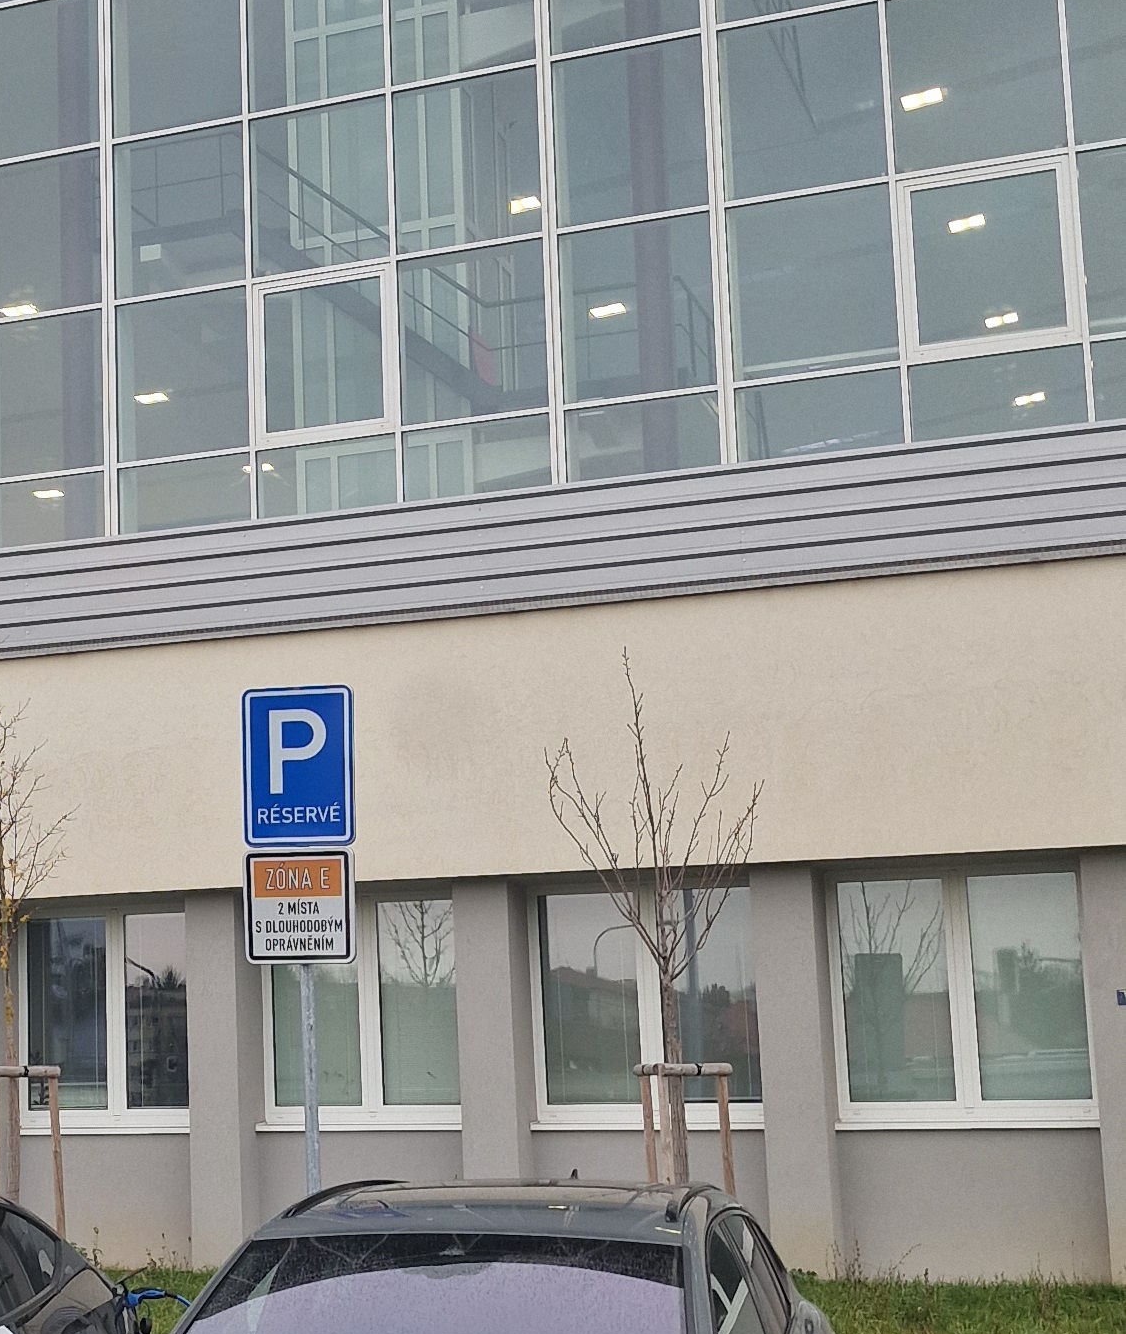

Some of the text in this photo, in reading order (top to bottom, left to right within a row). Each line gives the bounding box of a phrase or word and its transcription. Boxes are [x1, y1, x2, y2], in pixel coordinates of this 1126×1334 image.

[268, 708, 327, 795] P
[257, 802, 341, 825] RÉSERVÉ
[265, 862, 330, 890] ZÓNA E
[277, 898, 320, 915] 2 MÍSTA
[255, 916, 343, 933] S DLOUHODOBÝM
[265, 934, 334, 951] OPRÁVNĚNÍM
